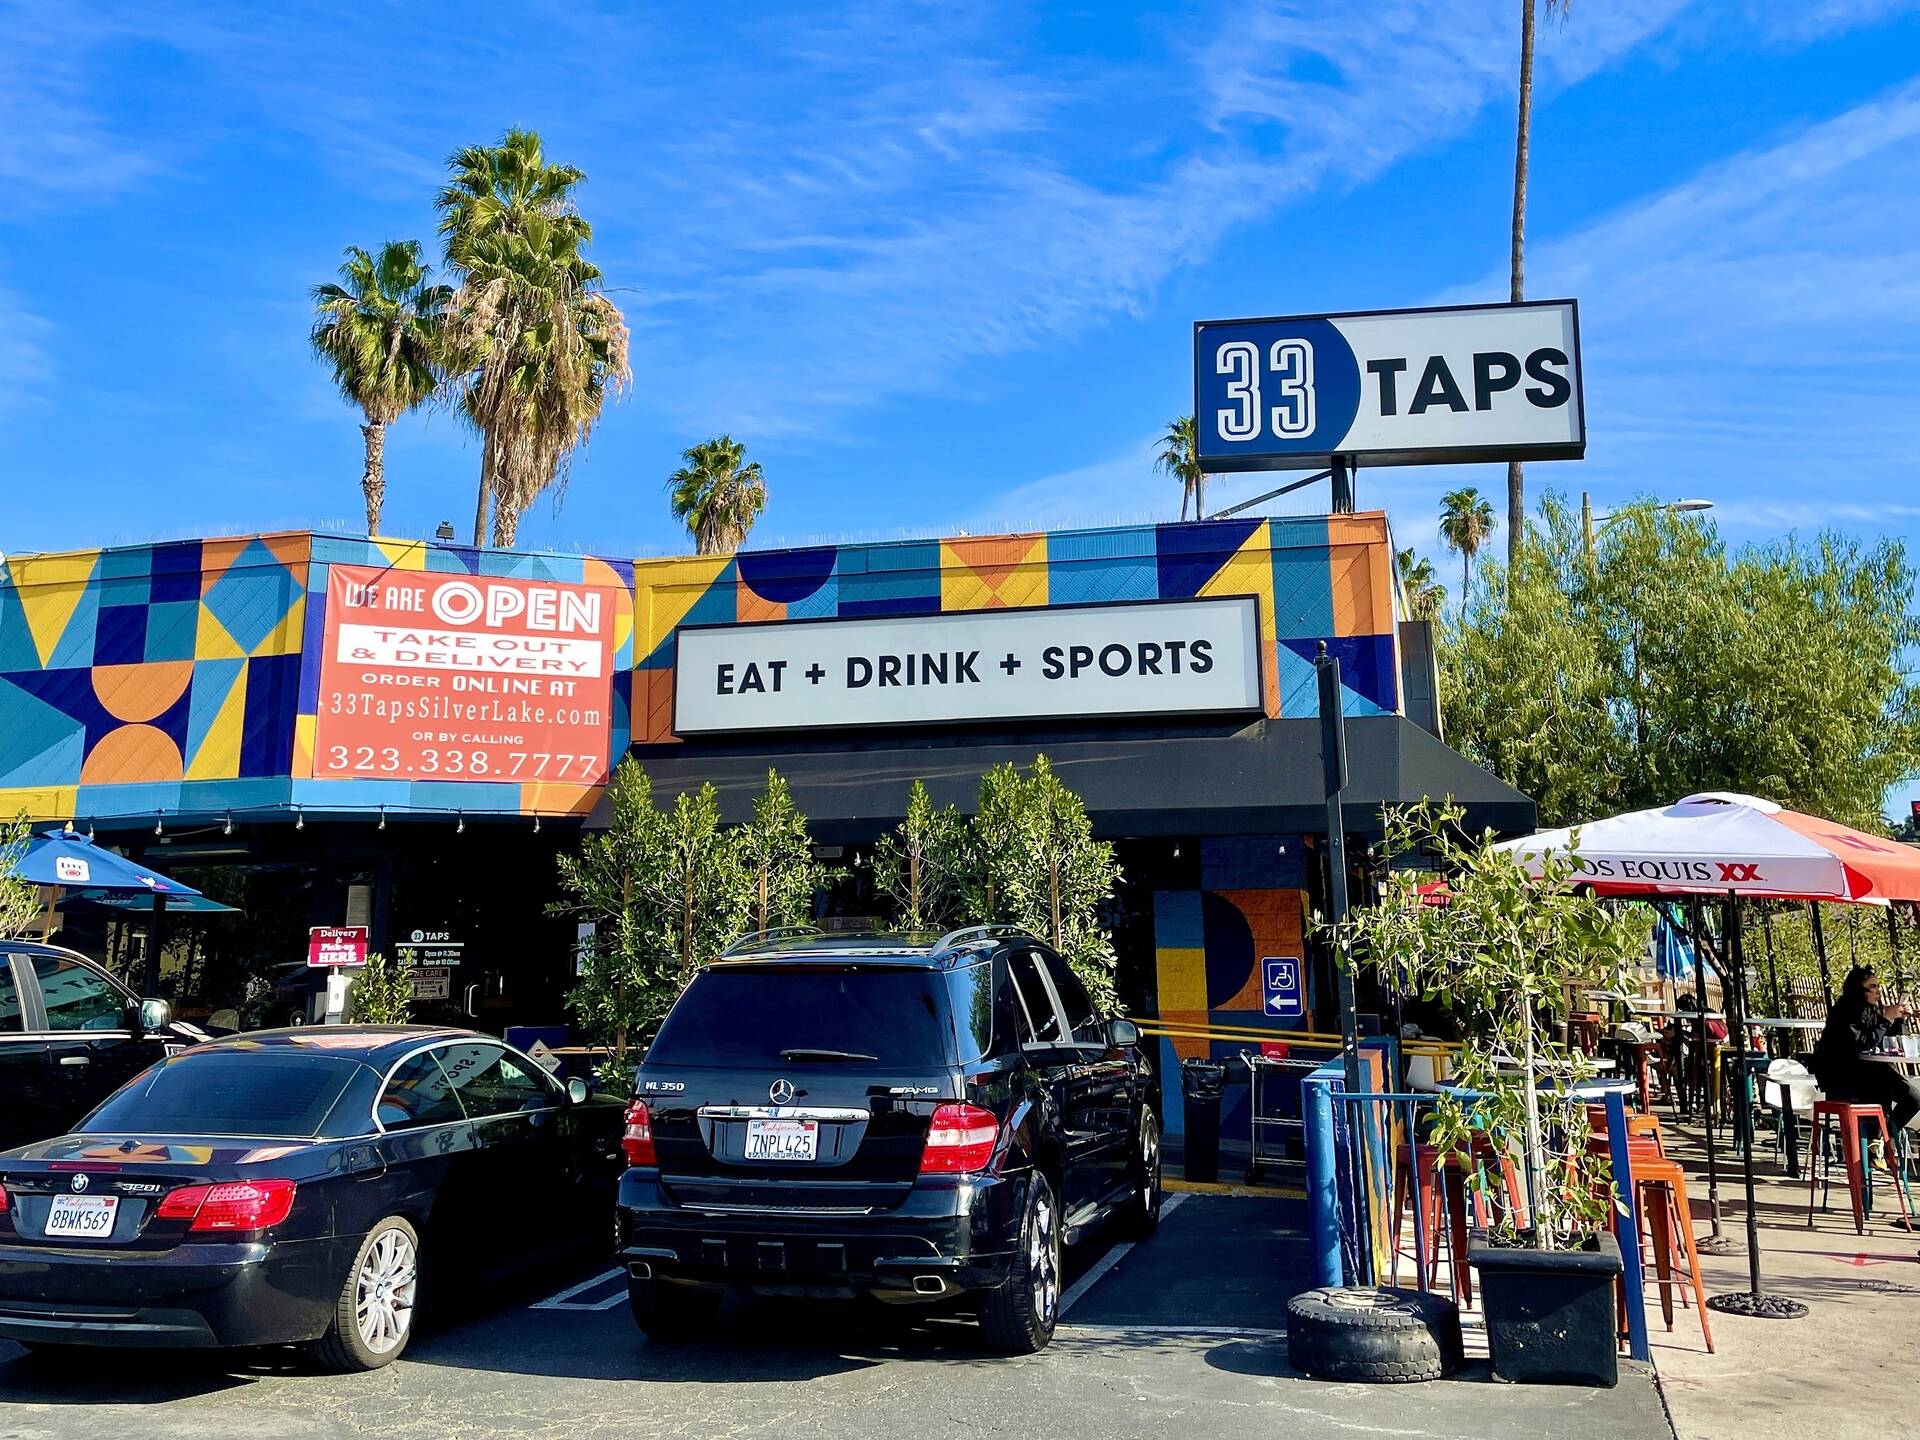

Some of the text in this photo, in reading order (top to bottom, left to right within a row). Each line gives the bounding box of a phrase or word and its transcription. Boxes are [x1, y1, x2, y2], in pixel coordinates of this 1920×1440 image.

[1216, 338, 1571, 442] 33 TAPS
[385, 586, 425, 612] ARE
[432, 581, 601, 634] OPEN
[374, 631, 571, 655] TAKE OUT
[351, 648, 588, 672] & DELIVERY
[716, 660, 788, 696] EAT
[846, 650, 981, 689] DRINK
[1041, 639, 1214, 680] SPORTS
[361, 673, 577, 697] ORDER ONLINE AT
[331, 692, 601, 726] 33TapsSilverLake.com
[412, 731, 524, 745] OR BY CALLING
[328, 745, 598, 779] 323.338.7777
[1620, 860, 1711, 881] EQUIS
[1715, 863, 1763, 882] XX
[320, 930, 358, 938] Delivery
[425, 932, 449, 940] TAPS
[318, 952, 358, 963] HERE
[321, 943, 356, 952] Pick-up
[645, 1081, 685, 1091] ML 350
[904, 1087, 939, 1095] AMG
[752, 1134, 811, 1154] 7NPL425
[65, 1197, 101, 1209] California
[51, 1209, 110, 1231] 8BWK569
